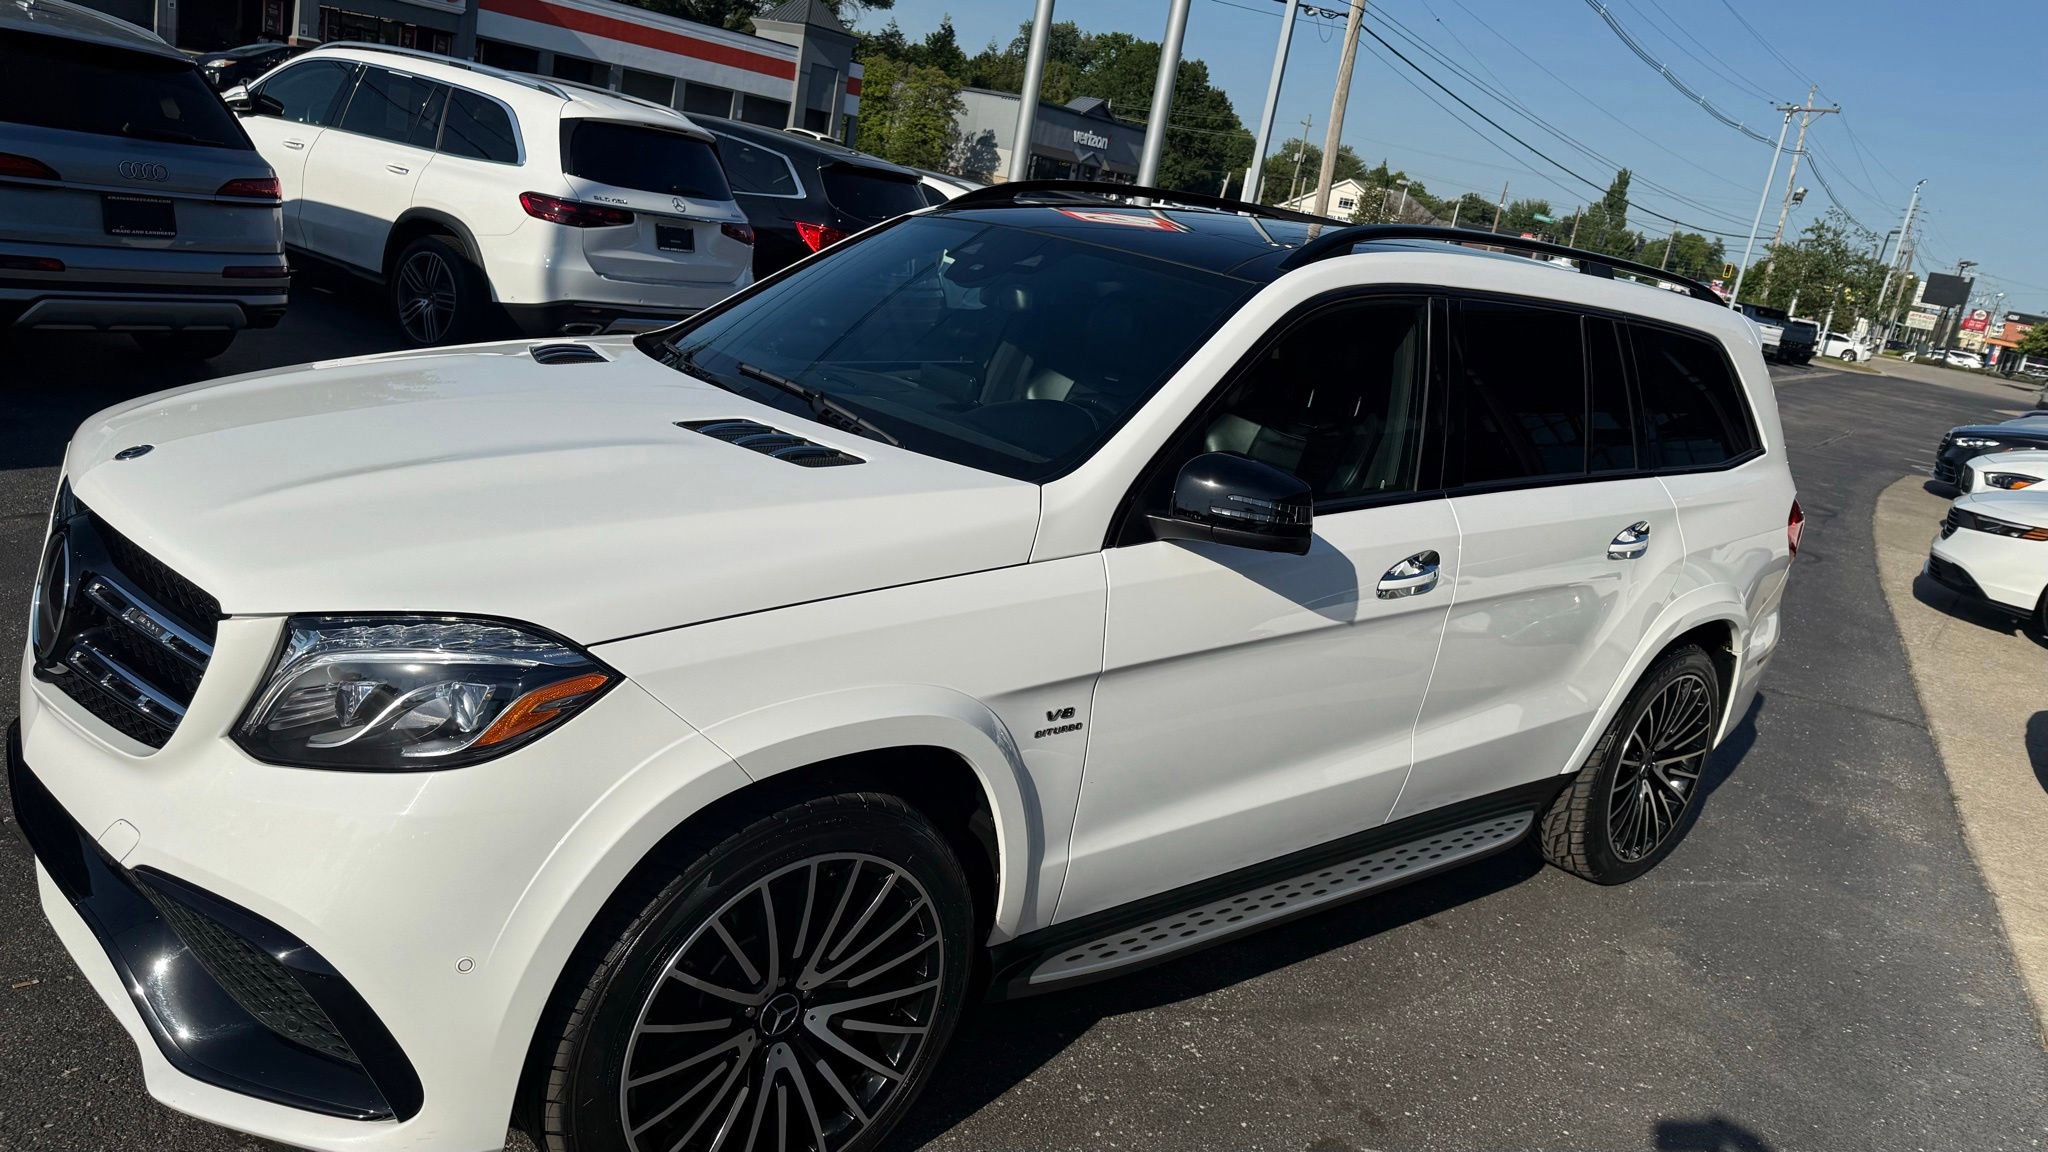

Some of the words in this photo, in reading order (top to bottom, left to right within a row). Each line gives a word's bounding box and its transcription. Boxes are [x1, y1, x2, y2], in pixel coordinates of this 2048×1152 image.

[1073, 130, 1108, 150] verizon
[1046, 706, 1076, 722] V8
[1034, 722, 1083, 739] BITURBO
